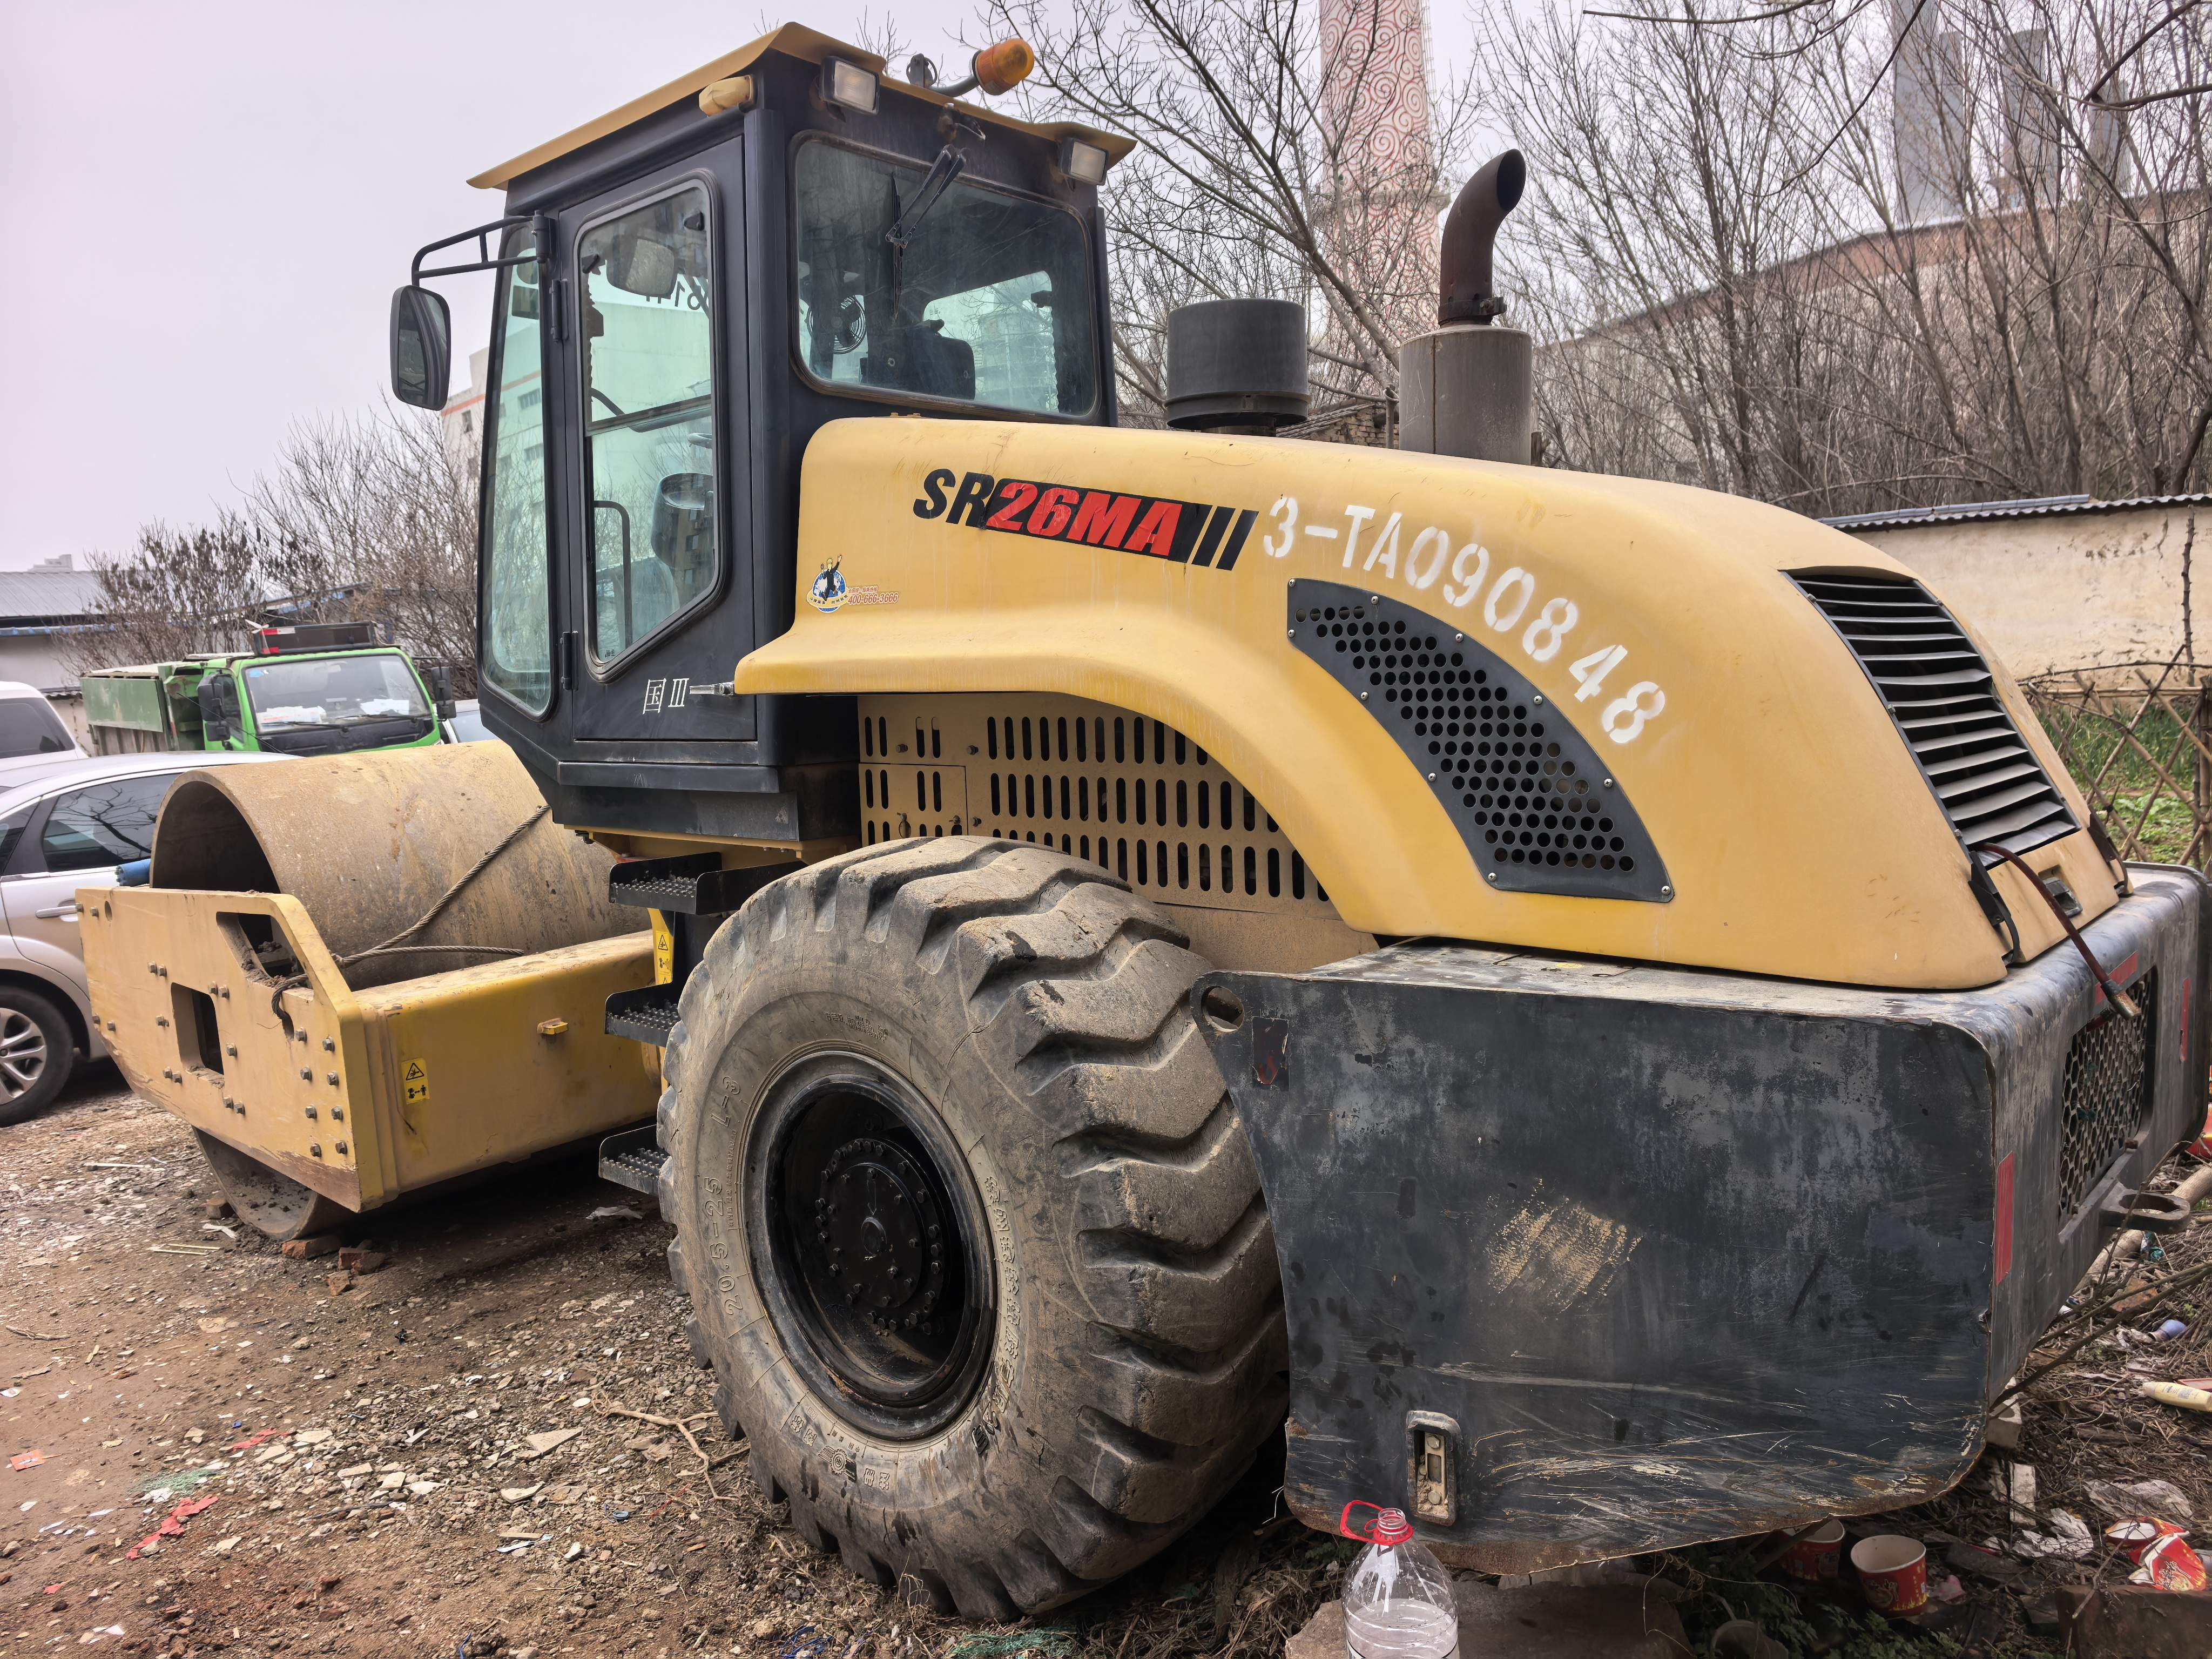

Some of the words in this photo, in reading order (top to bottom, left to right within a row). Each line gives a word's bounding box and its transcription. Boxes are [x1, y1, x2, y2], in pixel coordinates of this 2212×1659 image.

[913, 469, 1182, 556] SR26MA
[848, 592, 898, 605] 400-666-3666
[1264, 495, 1666, 746] 3-TA090848
[710, 1075, 741, 1128] L-3
[704, 1176, 743, 1316] 20.5-25
